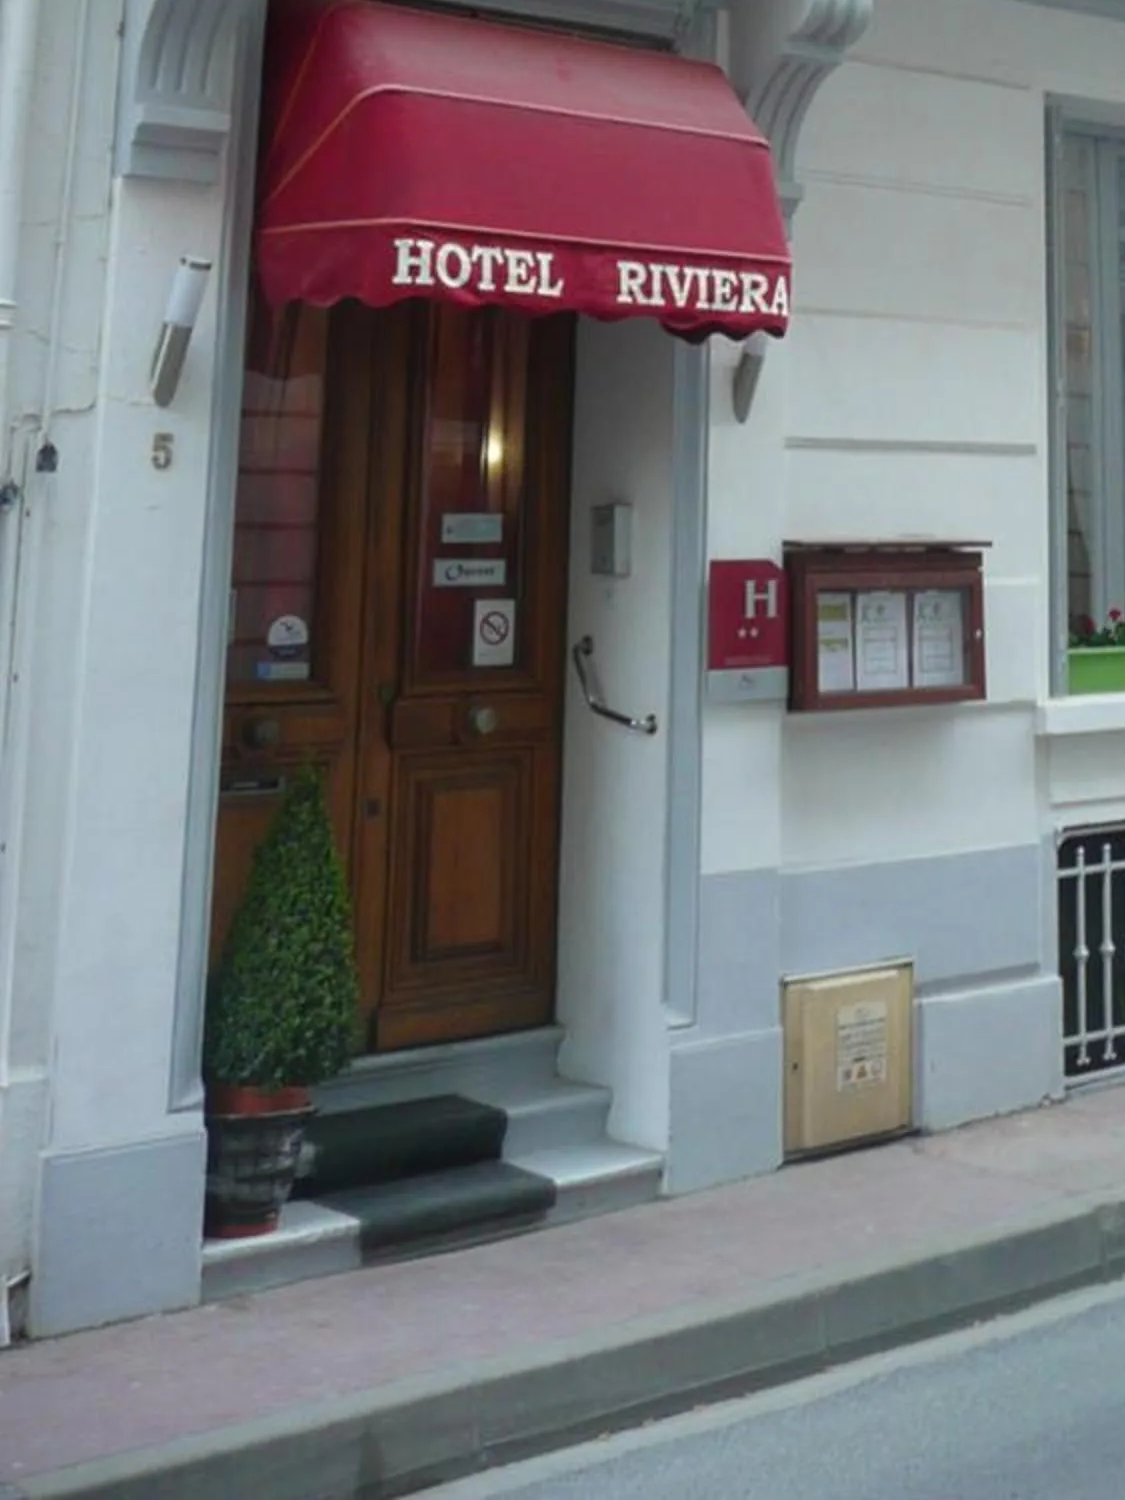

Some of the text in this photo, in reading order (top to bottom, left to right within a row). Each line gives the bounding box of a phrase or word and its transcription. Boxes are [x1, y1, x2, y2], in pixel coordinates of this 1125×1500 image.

[392, 238, 790, 317] HOTEL RIVIERA
[151, 432, 175, 471] 5
[744, 579, 778, 619] H
